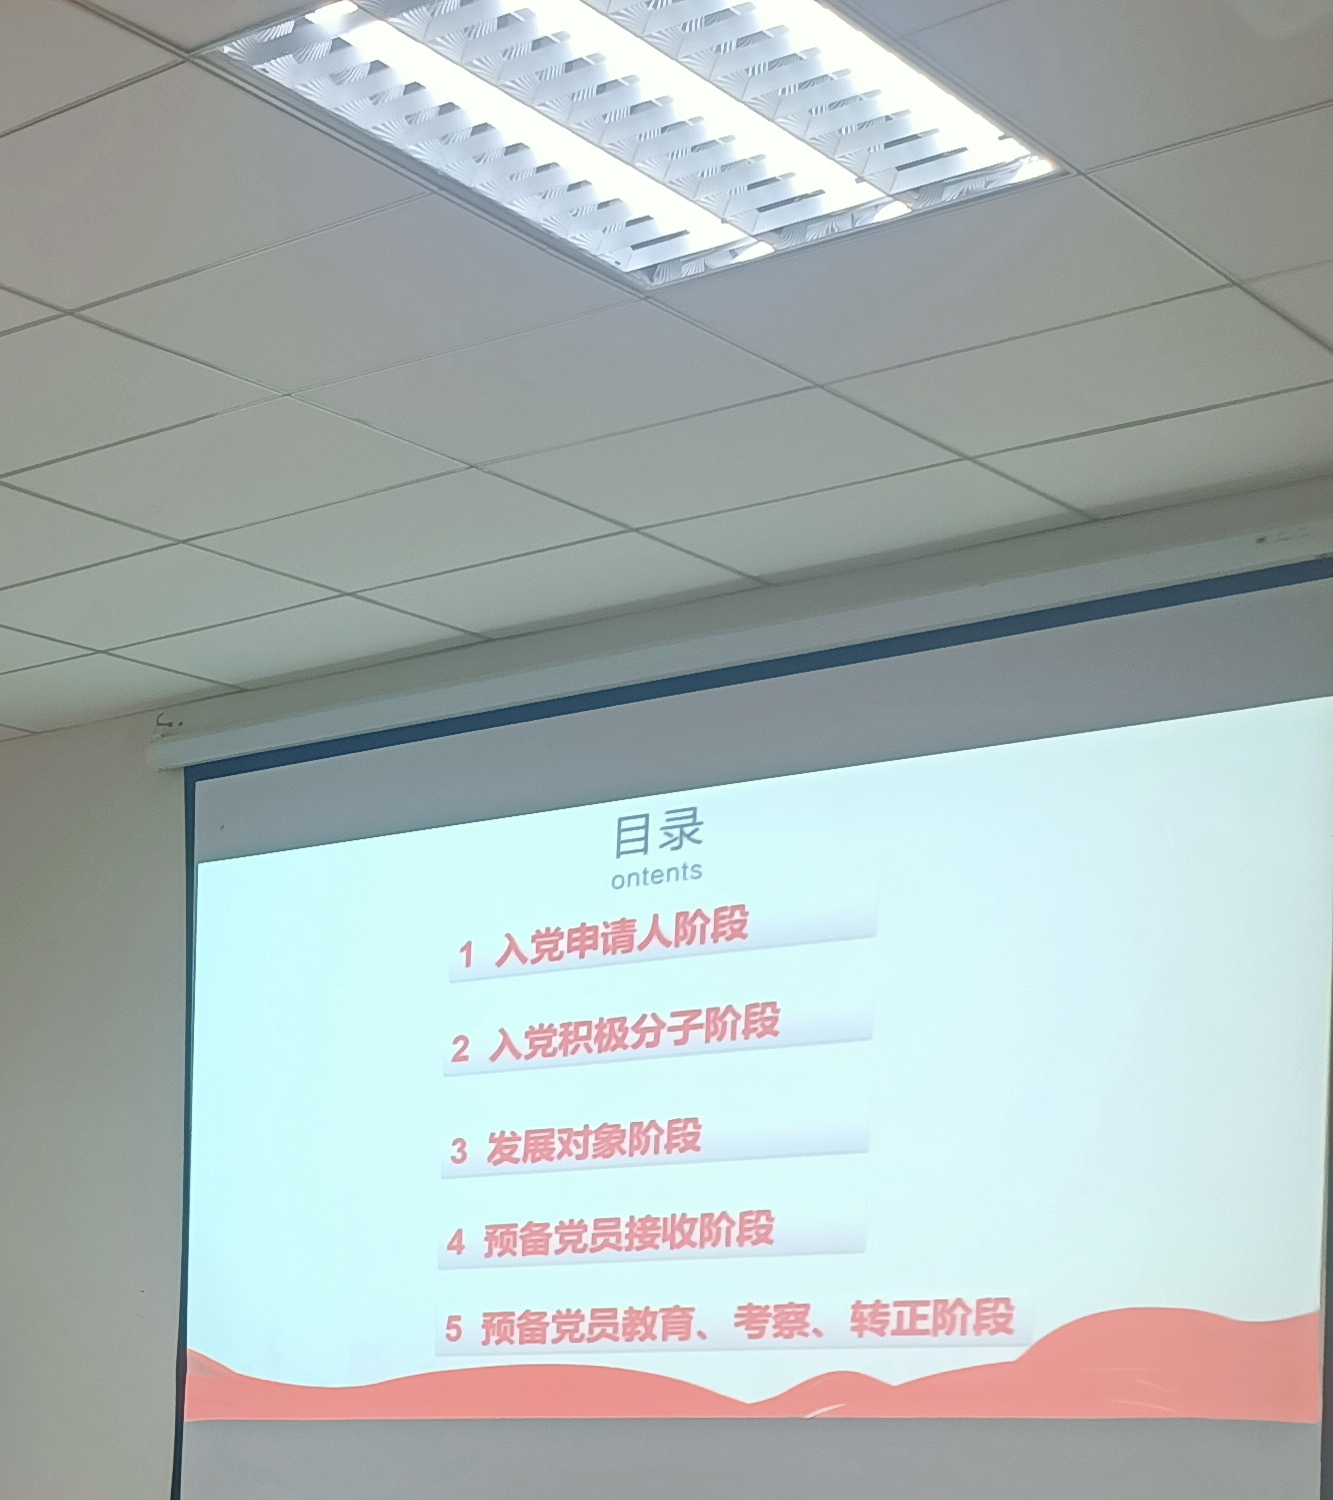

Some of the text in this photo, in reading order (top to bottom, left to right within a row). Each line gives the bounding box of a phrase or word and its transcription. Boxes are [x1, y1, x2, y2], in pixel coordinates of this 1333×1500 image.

[613, 806, 705, 860] 目录
[611, 863, 704, 891] ontents
[460, 904, 750, 969] 1 入党申请人阶段
[452, 1001, 782, 1064] 2 入党积极分子阶段
[450, 1117, 703, 1168] 3 发展对象阶段
[447, 1210, 777, 1260] 4 预备党员接收阶段
[445, 1296, 1017, 1347] 5 预备党员教育、考察、转正阶段
